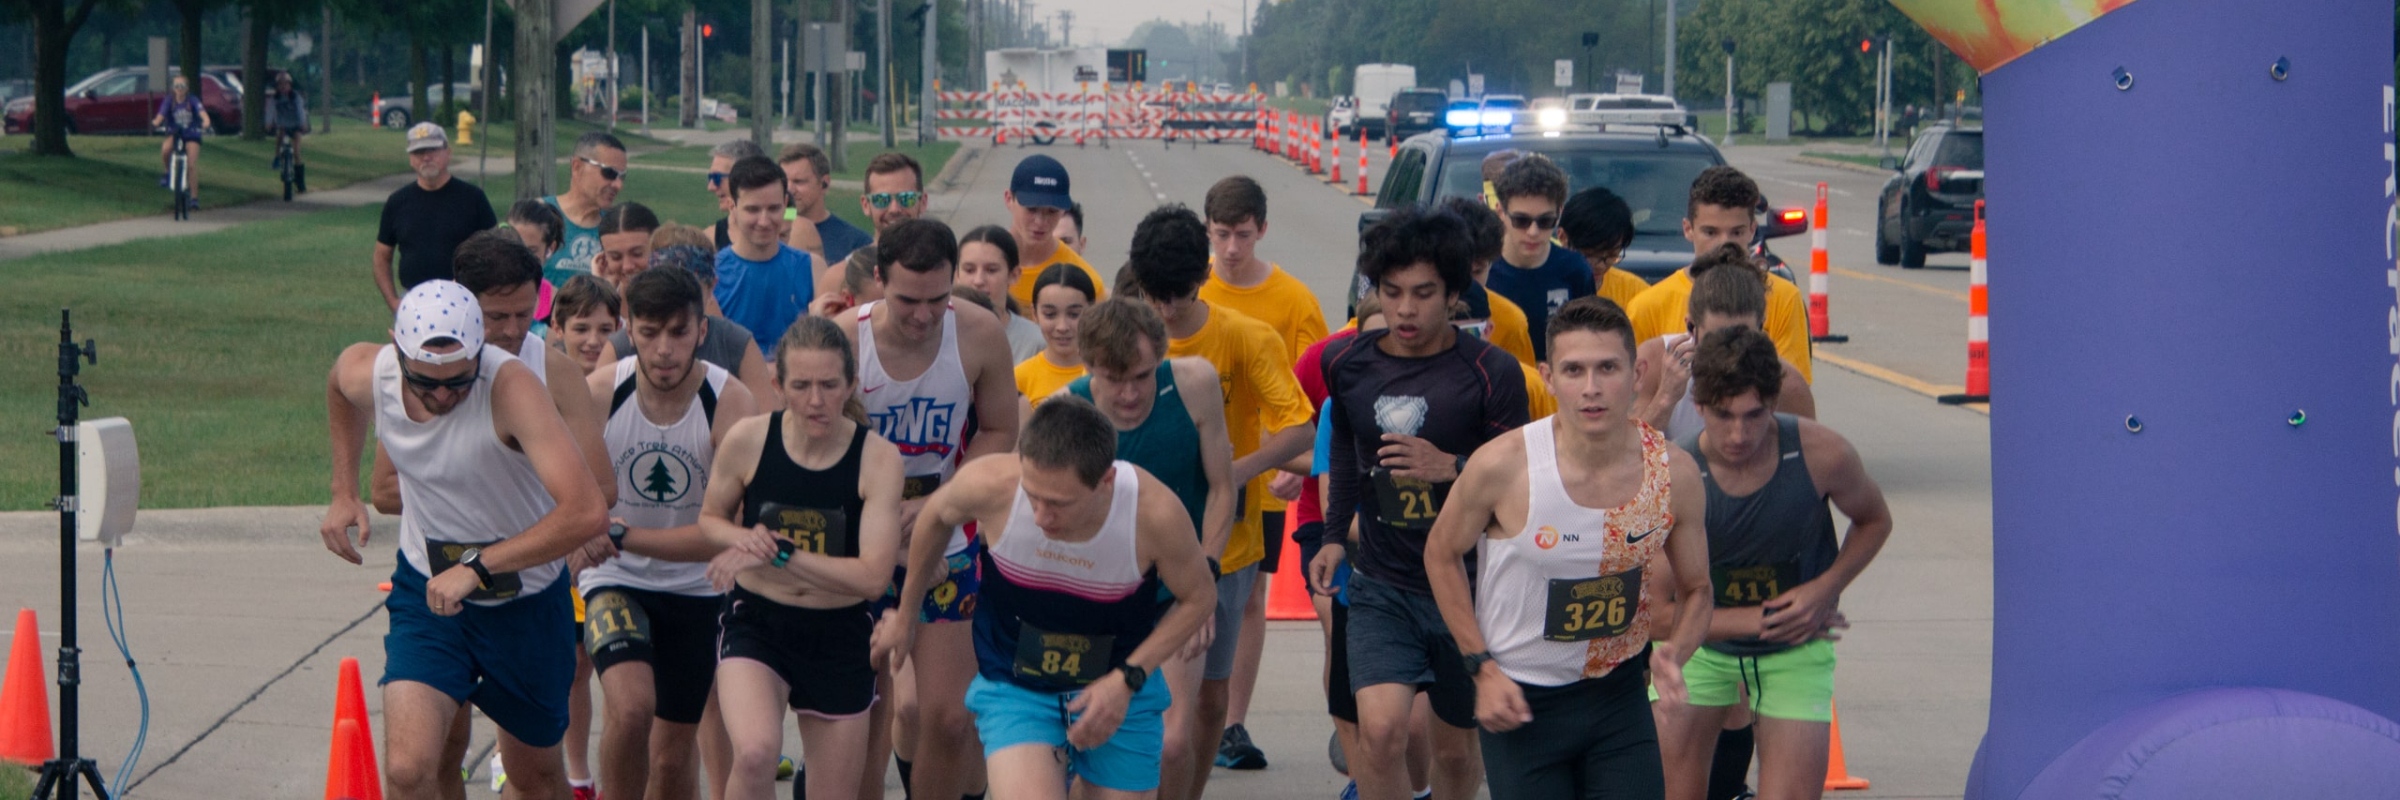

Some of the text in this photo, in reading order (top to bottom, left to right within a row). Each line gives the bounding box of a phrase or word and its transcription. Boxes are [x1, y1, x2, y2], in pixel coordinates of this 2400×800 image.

[638, 441, 668, 452] Tree
[1399, 491, 1437, 519] 21
[1563, 533, 1579, 542] NN
[1035, 549, 1094, 568] saucony
[1725, 579, 1779, 601] 411
[589, 607, 637, 644] 111
[1563, 596, 1627, 632] 326
[1042, 650, 1081, 677] 84
